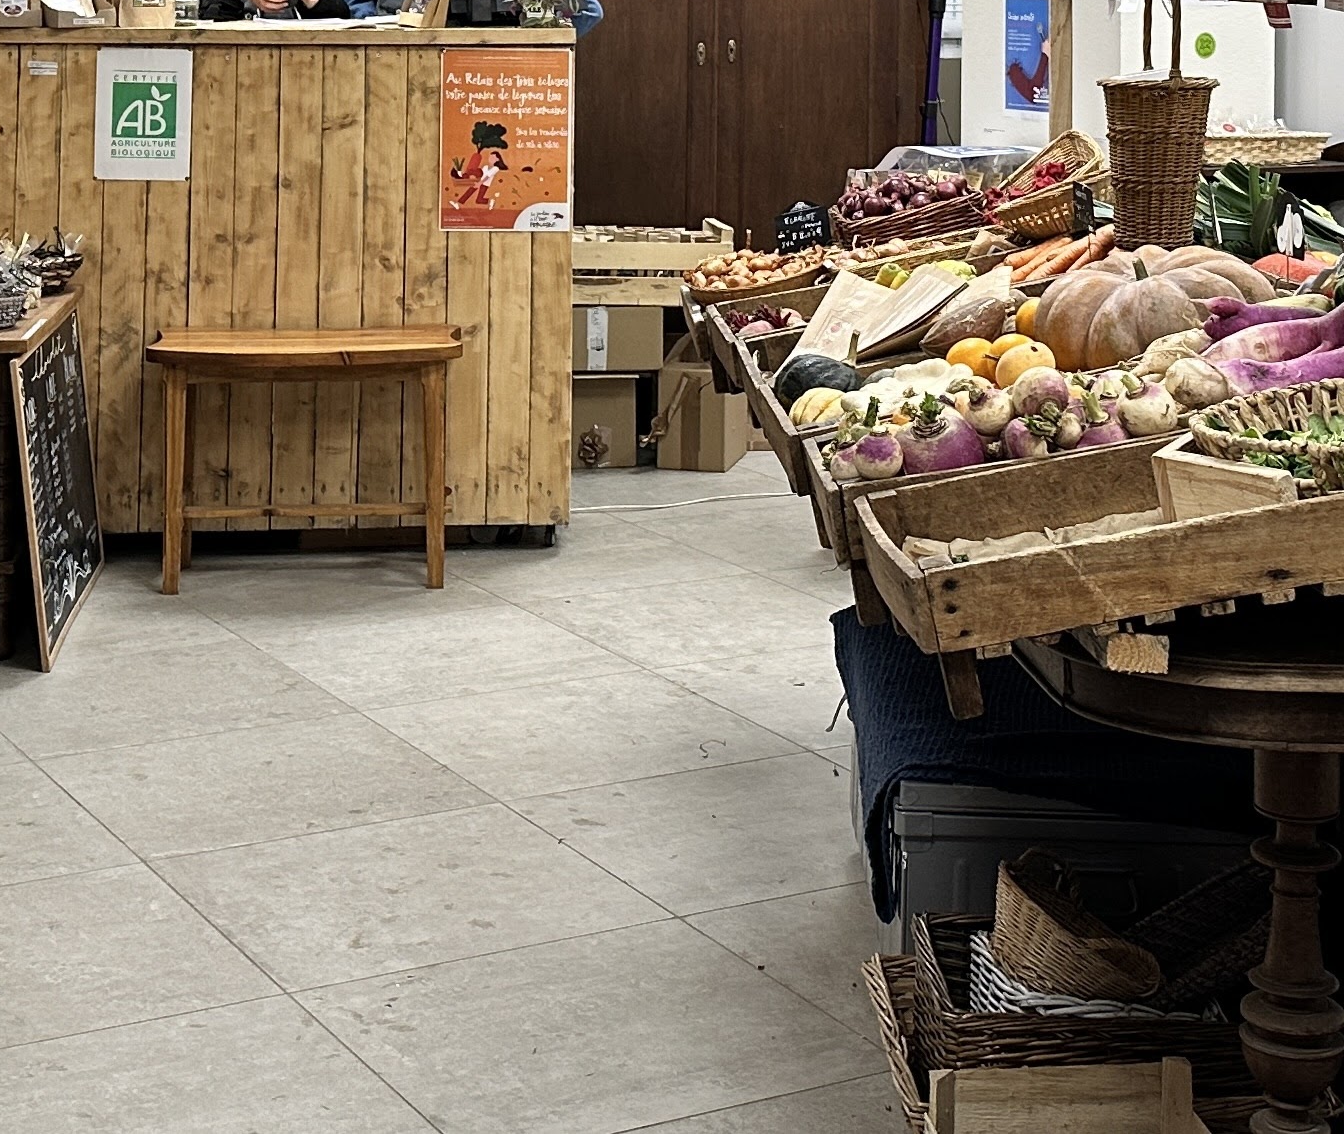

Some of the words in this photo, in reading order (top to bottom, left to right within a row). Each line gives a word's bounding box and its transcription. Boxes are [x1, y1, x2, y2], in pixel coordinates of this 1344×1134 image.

[445, 73, 462, 84] Au
[465, 73, 493, 87] Relais
[497, 73, 513, 87] des
[537, 74, 568, 87] écluses
[445, 87, 466, 100] votre
[468, 90, 494, 103] panier
[498, 87, 509, 100] de
[511, 88, 544, 107] légumes
[116, 99, 167, 136] AB
[460, 103, 471, 115] et
[471, 103, 500, 115] locaux
[502, 102, 532, 120] chaque
[534, 104, 567, 116] semaine
[111, 139, 176, 147] AGRICULTURE
[516, 140, 526, 149] de
[111, 149, 175, 157] BIOLOGIQUE
